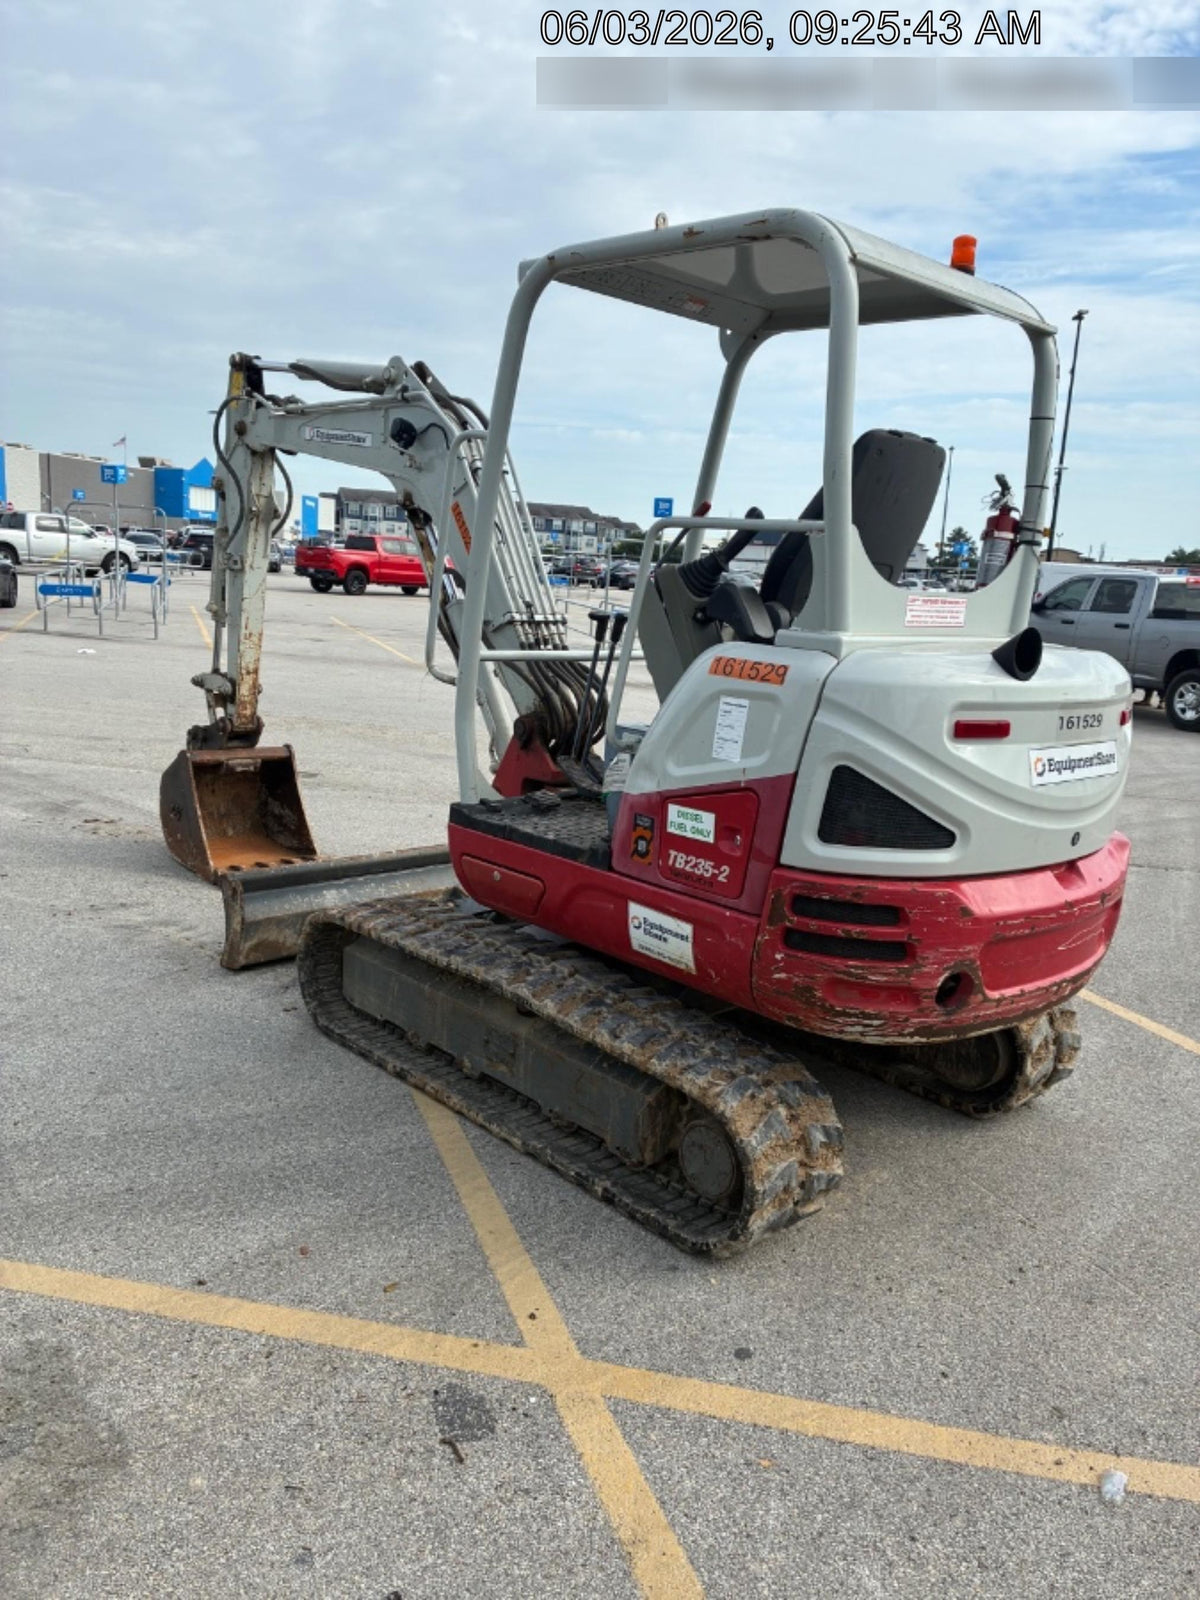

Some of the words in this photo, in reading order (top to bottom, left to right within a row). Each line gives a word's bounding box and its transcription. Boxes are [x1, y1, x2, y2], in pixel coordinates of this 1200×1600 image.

[713, 656, 789, 685] 161529
[1058, 713, 1103, 731] 161529
[1046, 751, 1116, 775] EquipmentShare
[677, 809, 705, 824] DIESEL
[670, 820, 688, 833] FUEL
[689, 825, 712, 839] ONLY
[668, 849, 730, 883] TB235-2
[643, 916, 689, 943] Equipment
